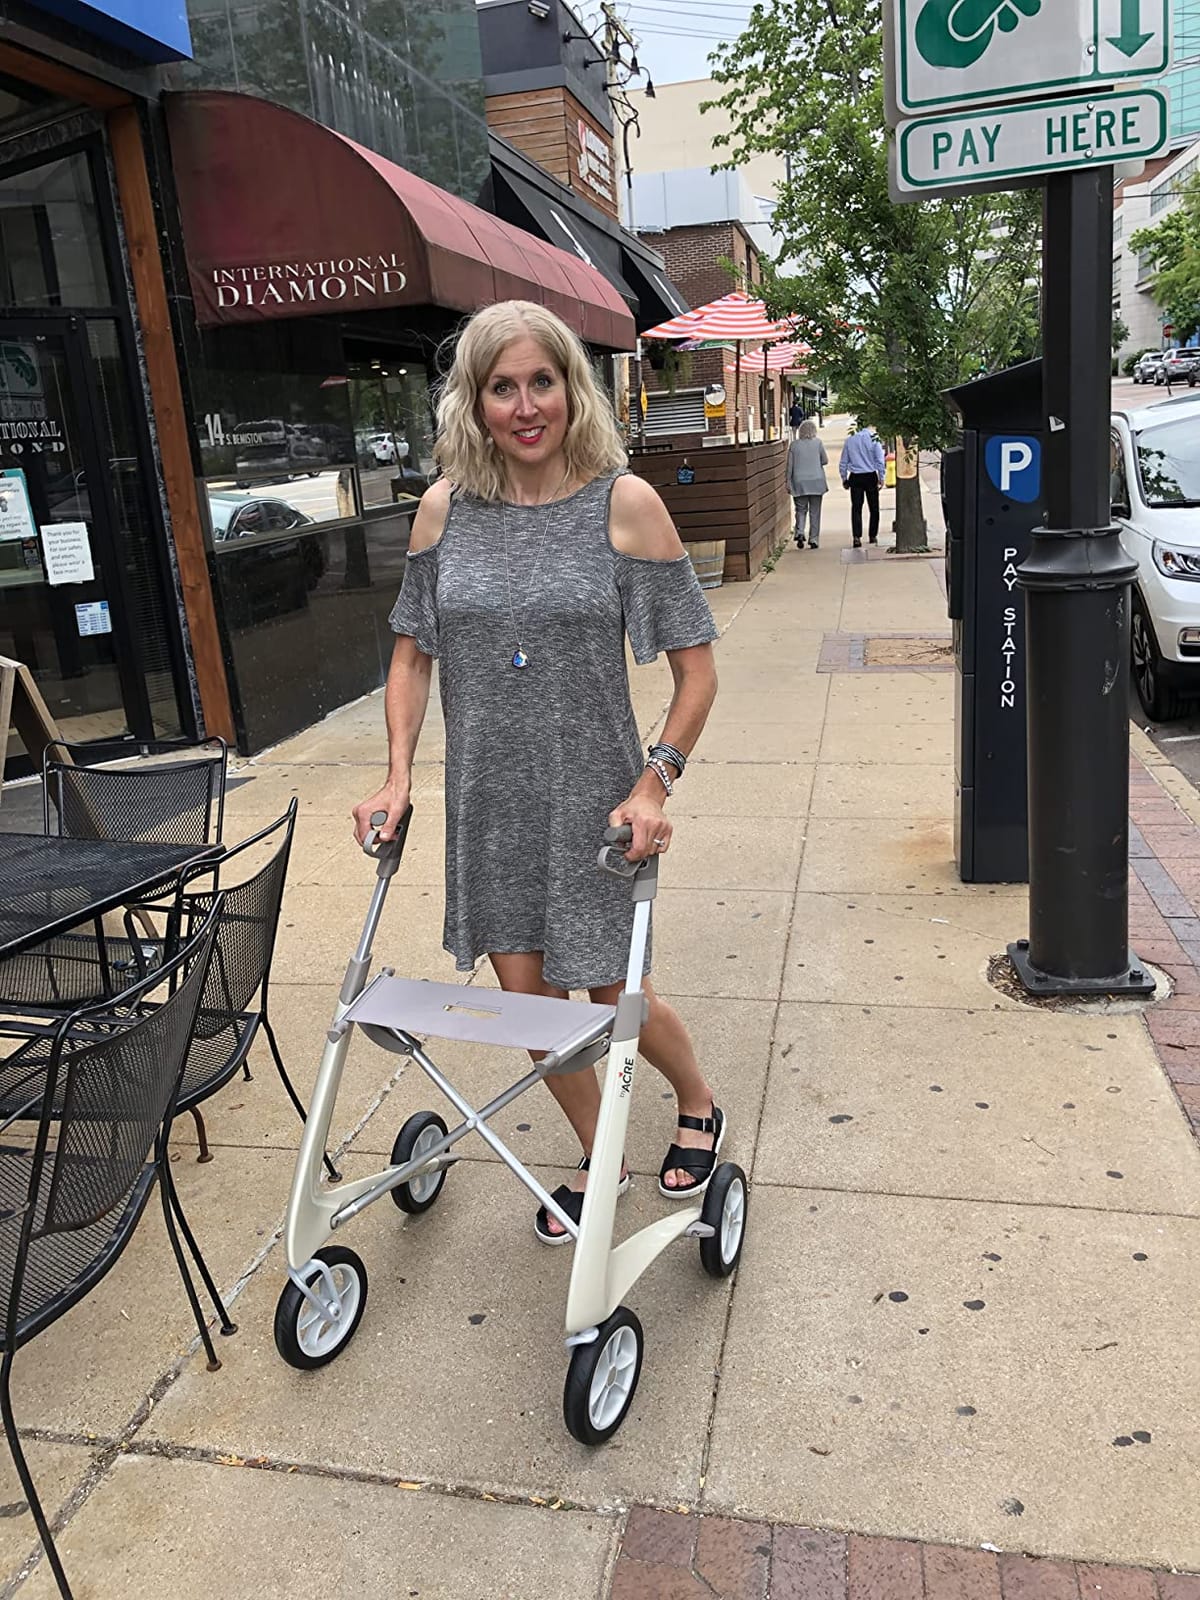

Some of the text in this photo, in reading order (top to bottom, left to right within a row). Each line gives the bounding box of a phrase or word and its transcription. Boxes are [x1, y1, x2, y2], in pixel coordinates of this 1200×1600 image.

[932, 106, 1140, 170] PAY HERE
[213, 253, 405, 283] INTERNATIONAL
[216, 270, 407, 308] DIAMOND
[0, 420, 62, 440] TIONAL
[204, 413, 224, 446] 14
[1000, 442, 1033, 491] P
[1000, 547, 1018, 708] PAY STATION
[622, 1057, 634, 1092] ACRE
